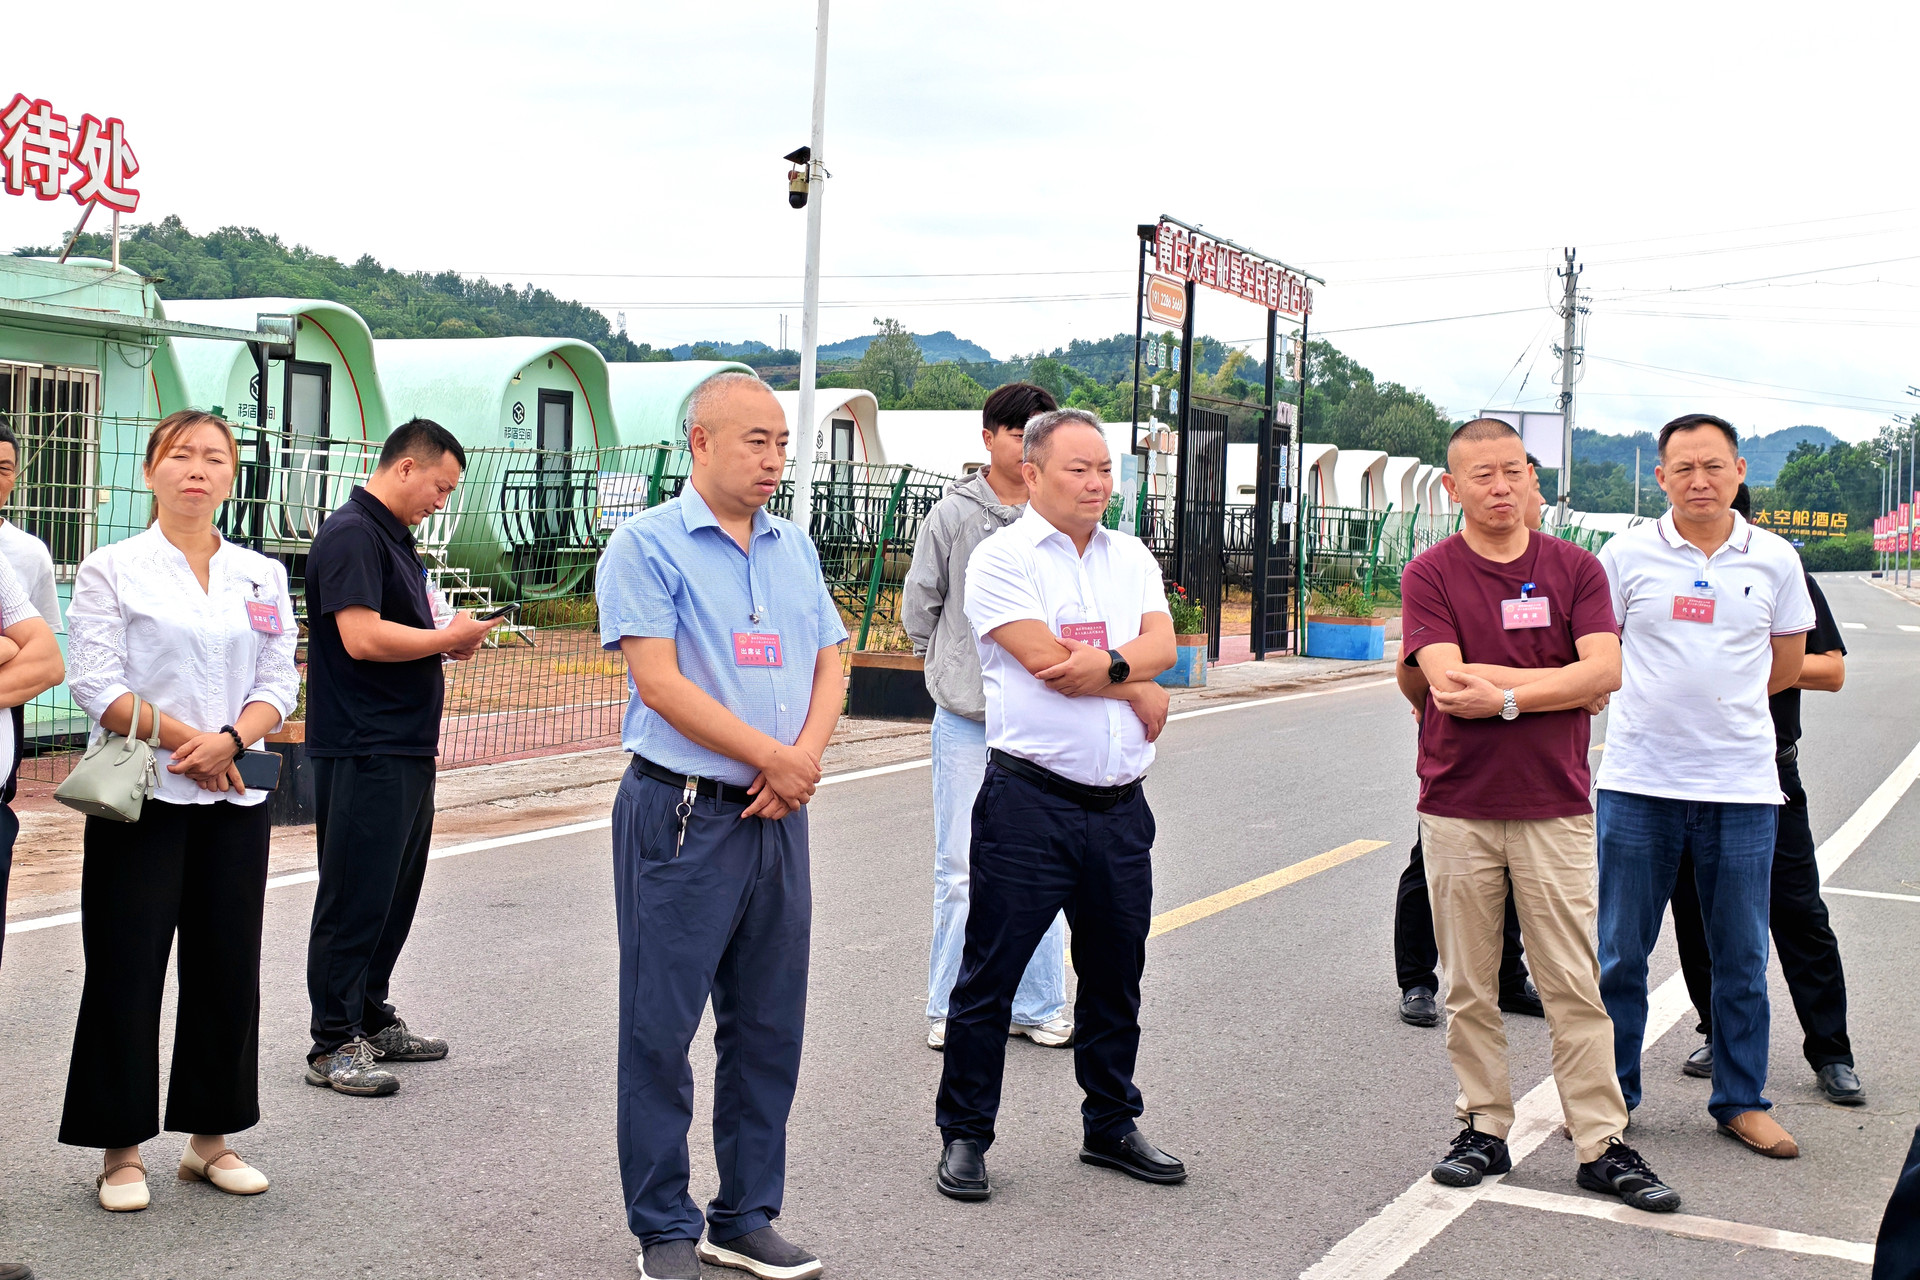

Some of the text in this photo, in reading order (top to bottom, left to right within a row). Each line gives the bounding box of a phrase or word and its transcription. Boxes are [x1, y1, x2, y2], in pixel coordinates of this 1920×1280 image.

[1, 94, 139, 211] 待处
[238, 403, 276, 420] 移宿间
[1756, 509, 1848, 528] 太空舱酒店
